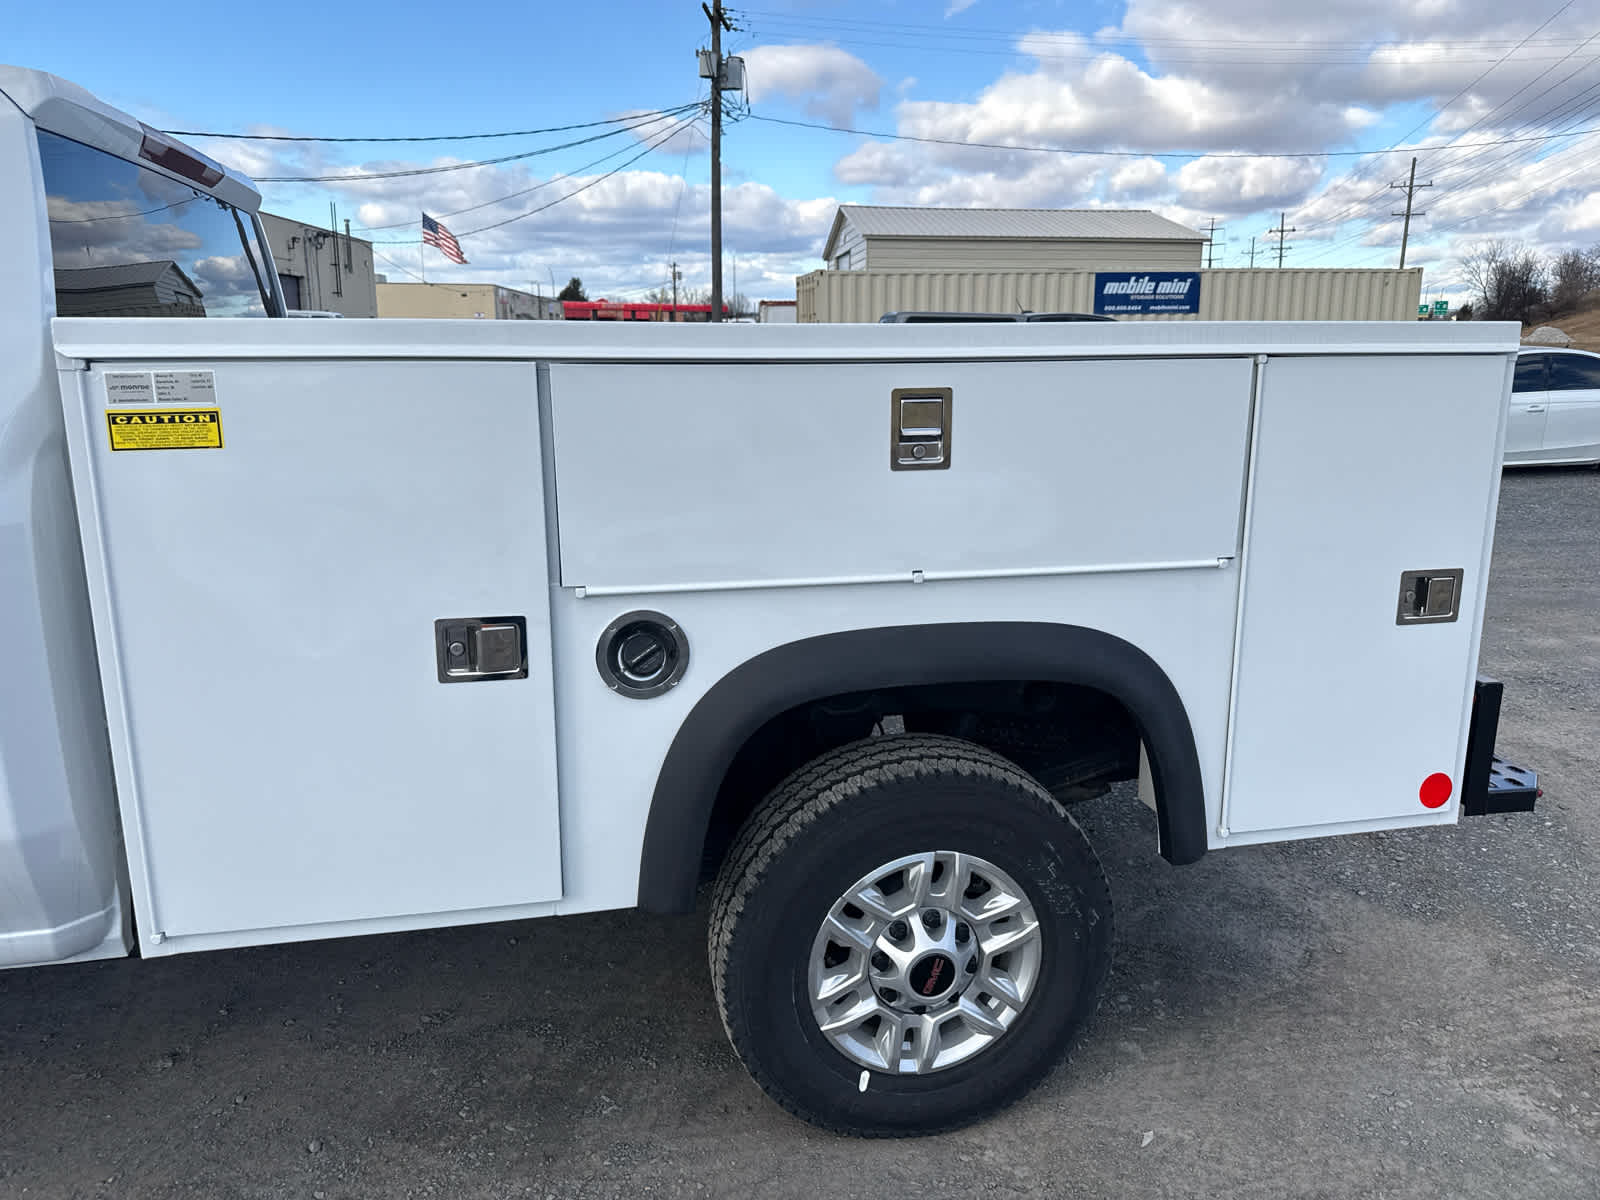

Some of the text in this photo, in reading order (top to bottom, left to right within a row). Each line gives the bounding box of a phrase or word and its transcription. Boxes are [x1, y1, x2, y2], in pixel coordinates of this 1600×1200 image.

[1103, 276, 1193, 295] mobile mini
[115, 414, 211, 424] CAUTION
[922, 958, 945, 995] GMC
